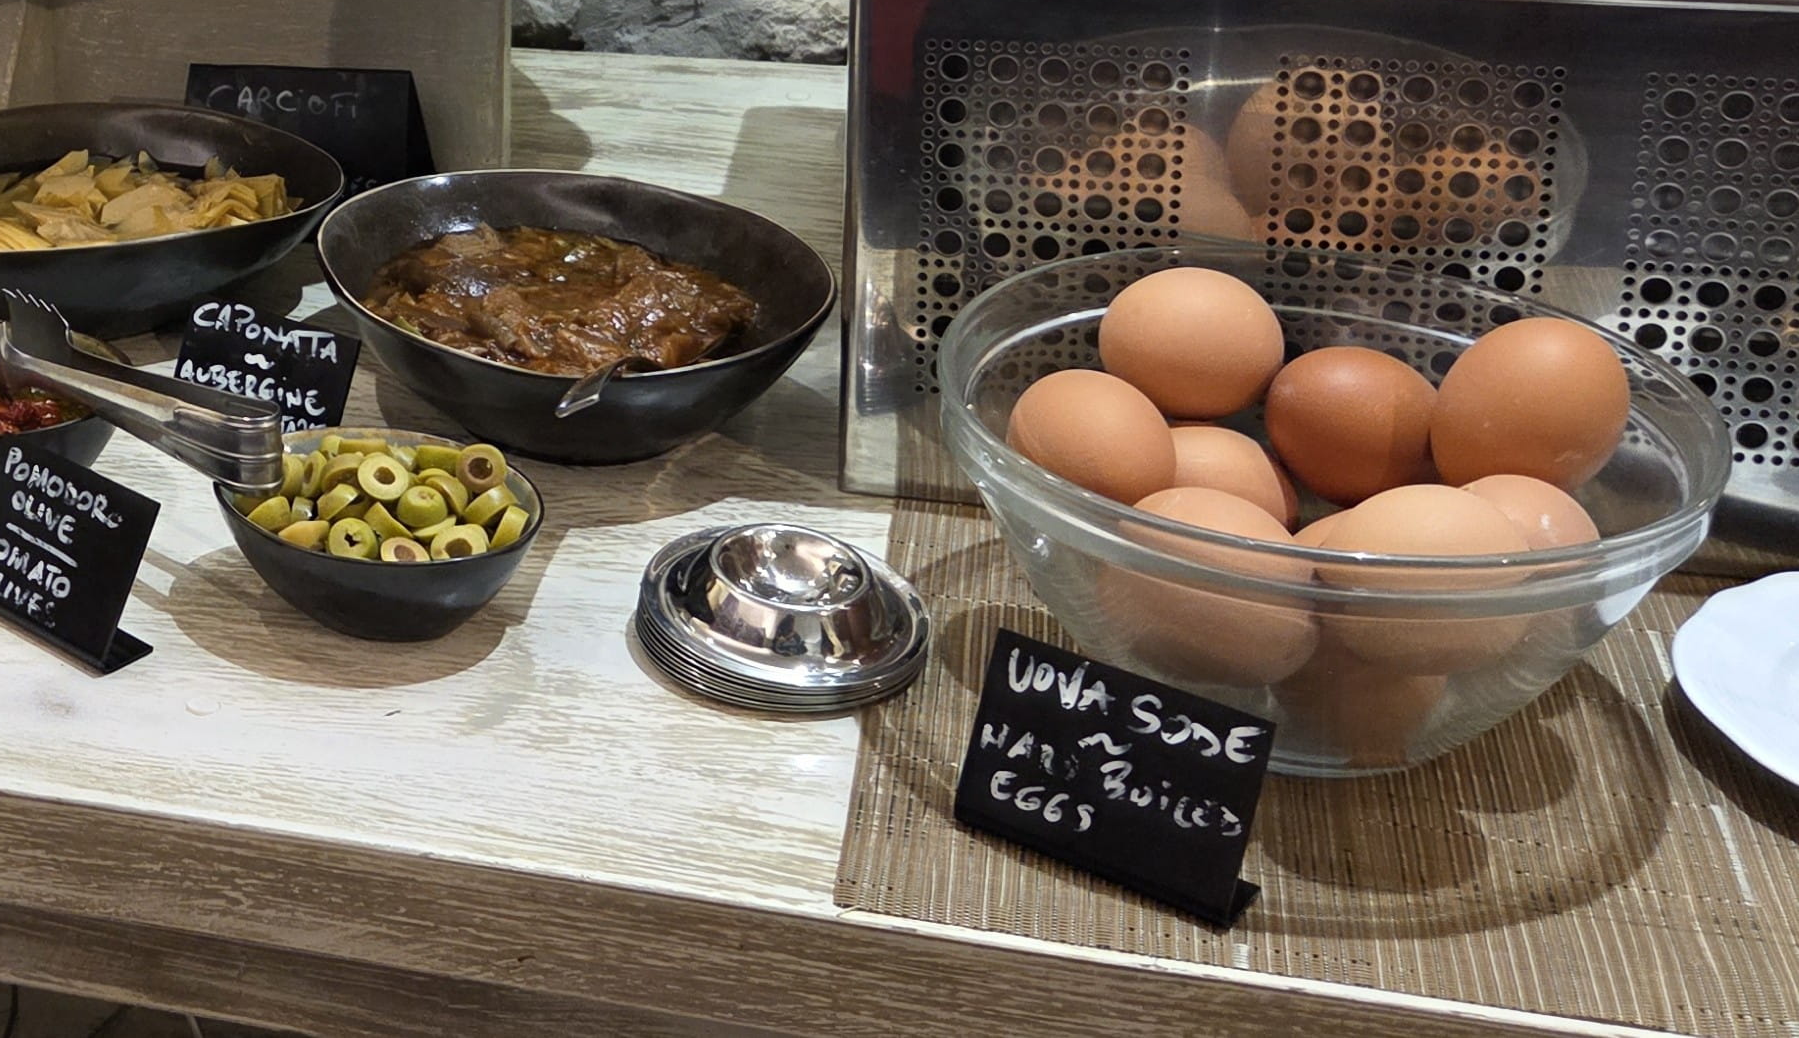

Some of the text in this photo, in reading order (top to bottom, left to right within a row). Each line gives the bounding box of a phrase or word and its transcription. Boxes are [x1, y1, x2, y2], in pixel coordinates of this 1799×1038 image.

[193, 302, 338, 364] CAPONATA
[11, 490, 77, 545] OLIVE
[1008, 647, 1267, 763] UOVA SODE
[990, 770, 1095, 831] EGGS
